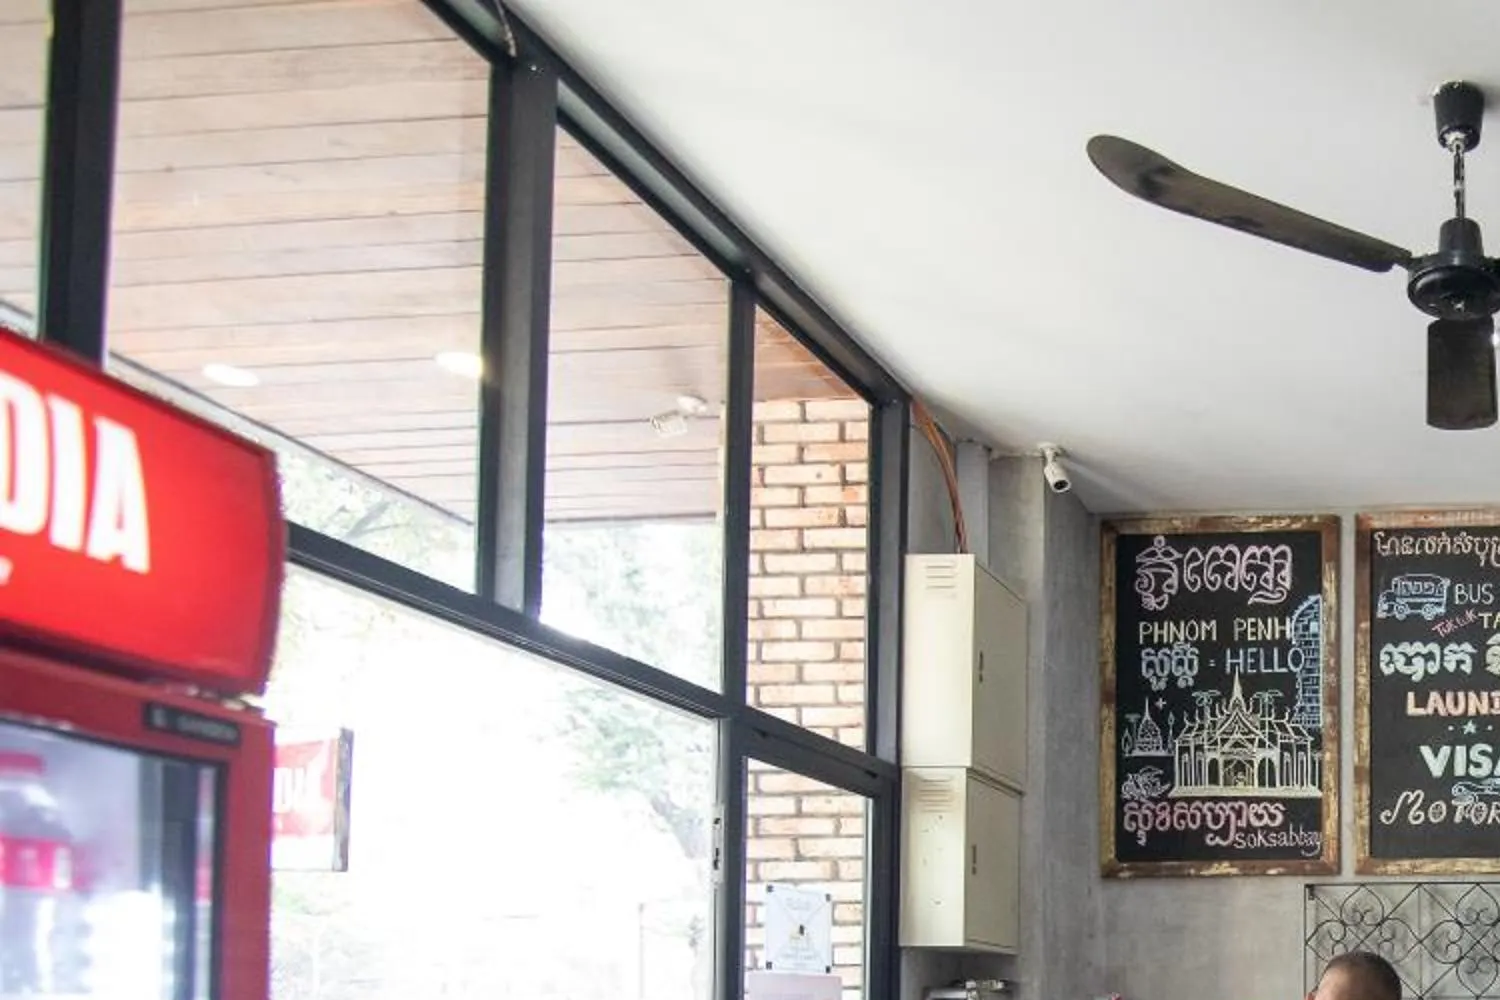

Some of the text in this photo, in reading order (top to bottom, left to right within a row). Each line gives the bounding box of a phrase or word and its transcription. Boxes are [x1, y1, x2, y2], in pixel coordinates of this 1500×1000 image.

[1455, 583, 1495, 605] BUS
[1139, 616, 1292, 645] PHNOM PENH
[1225, 646, 1306, 675] HELLO
